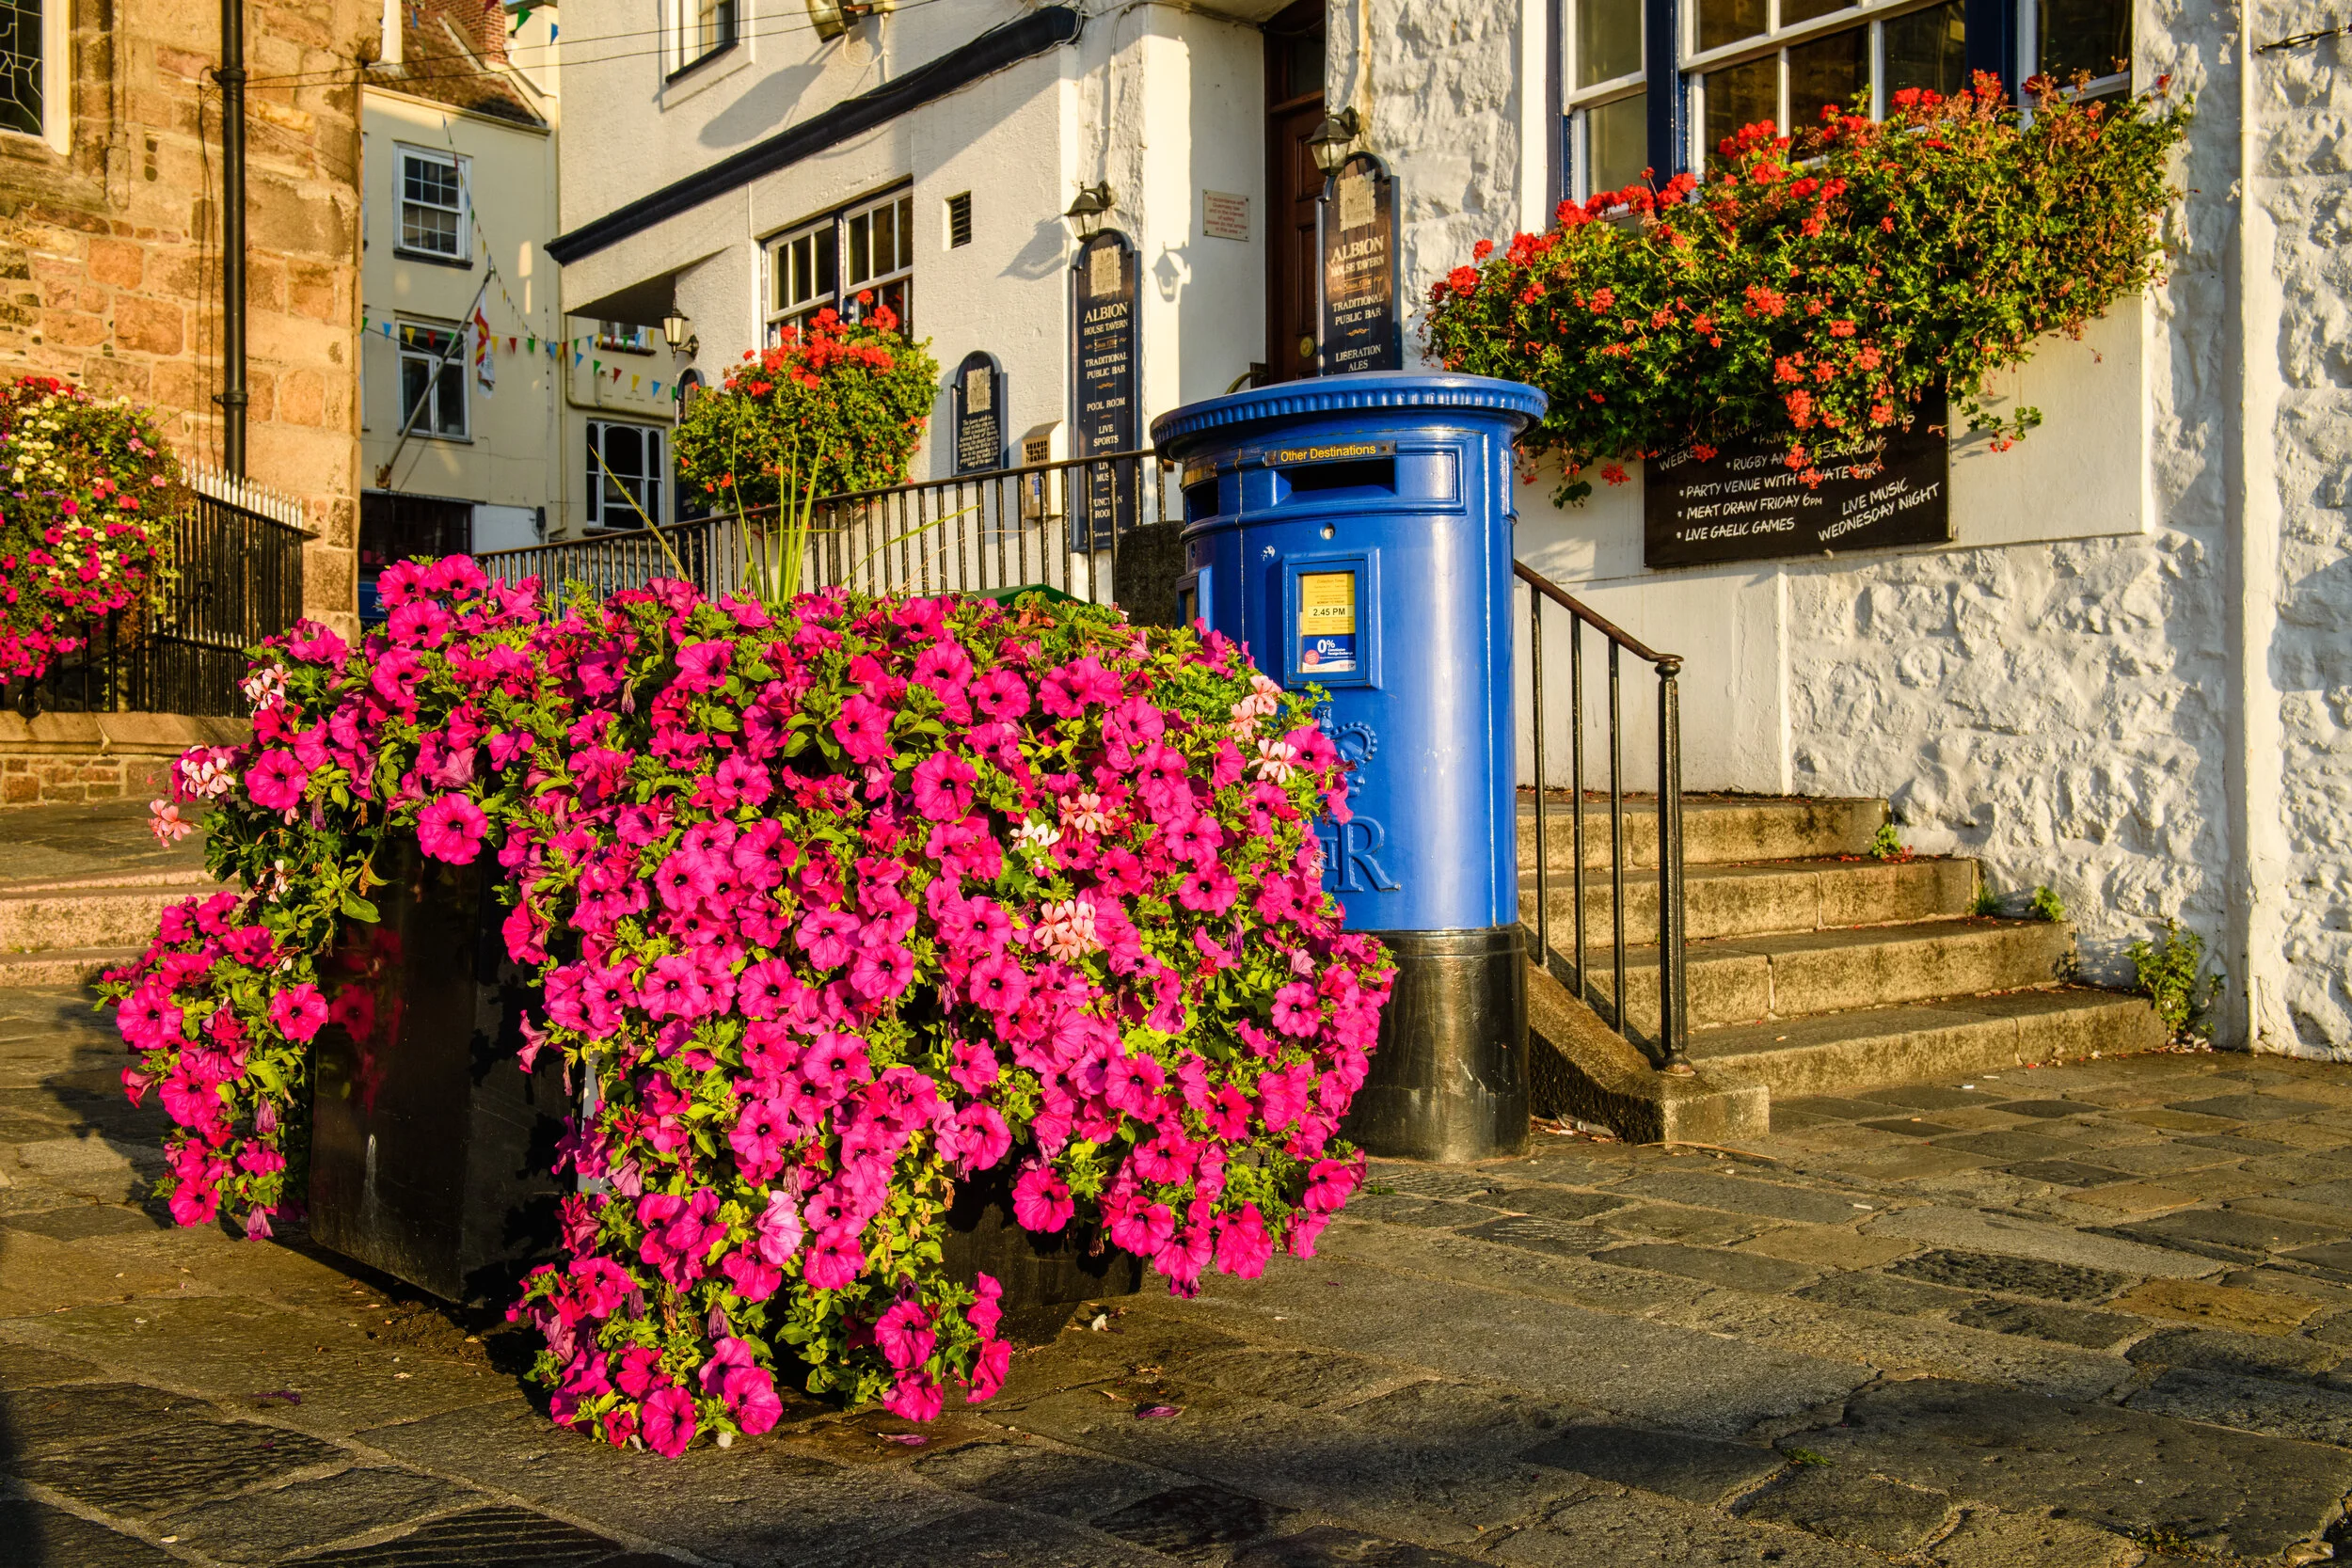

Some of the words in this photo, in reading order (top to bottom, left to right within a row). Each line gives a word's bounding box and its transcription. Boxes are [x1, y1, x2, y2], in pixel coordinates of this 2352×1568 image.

[1331, 235, 1385, 263] ALBION
[1356, 255, 1385, 272] TAVERN
[1332, 293, 1385, 312] TRADITIONAL
[1084, 302, 1129, 324] ALBION
[1335, 311, 1362, 325] PUBLIC
[1365, 307, 1382, 320] BAR
[1104, 319, 1129, 332] TAVERN
[1085, 352, 1128, 368] TRADITIONAL
[1336, 343, 1382, 362] LIBERATION
[1087, 368, 1110, 380] PUBLIC
[1112, 364, 1126, 375] BAR
[1348, 359, 1369, 372] ALES
[1087, 401, 1104, 412] POOL
[1106, 397, 1126, 408] ROOM
[1098, 424, 1114, 435] LIVE
[1093, 435, 1119, 447] SPORTS
[1280, 450, 1308, 462] Other
[1310, 445, 1376, 460] Destinations
[1734, 455, 1767, 470] RUGBY
[1771, 451, 1790, 465] AN
[1841, 437, 1887, 457] RACING
[1098, 462, 1109, 471] LIV
[1686, 483, 1722, 499] PARTY
[1724, 477, 1760, 493] VENUE
[1764, 472, 1796, 488] WITH
[1800, 466, 1850, 484] PVATE
[1092, 495, 1123, 507] UNCTN
[1842, 494, 1867, 515] LIVE
[1869, 477, 1909, 504] MUSIC
[1687, 503, 1722, 519] MEAT
[1723, 499, 1758, 515] DRAW
[1760, 494, 1800, 511] FRIDAY
[1818, 500, 1895, 541] WEDNESDAY
[1899, 482, 1940, 511] NIGHT
[1685, 527, 1708, 542] LIVE
[1710, 522, 1750, 539] GAELIC
[1752, 517, 1795, 534] GAMES
[1313, 608, 1330, 616] 2.45
[1332, 608, 1345, 616] PM
[1317, 639, 1336, 654] 0%
